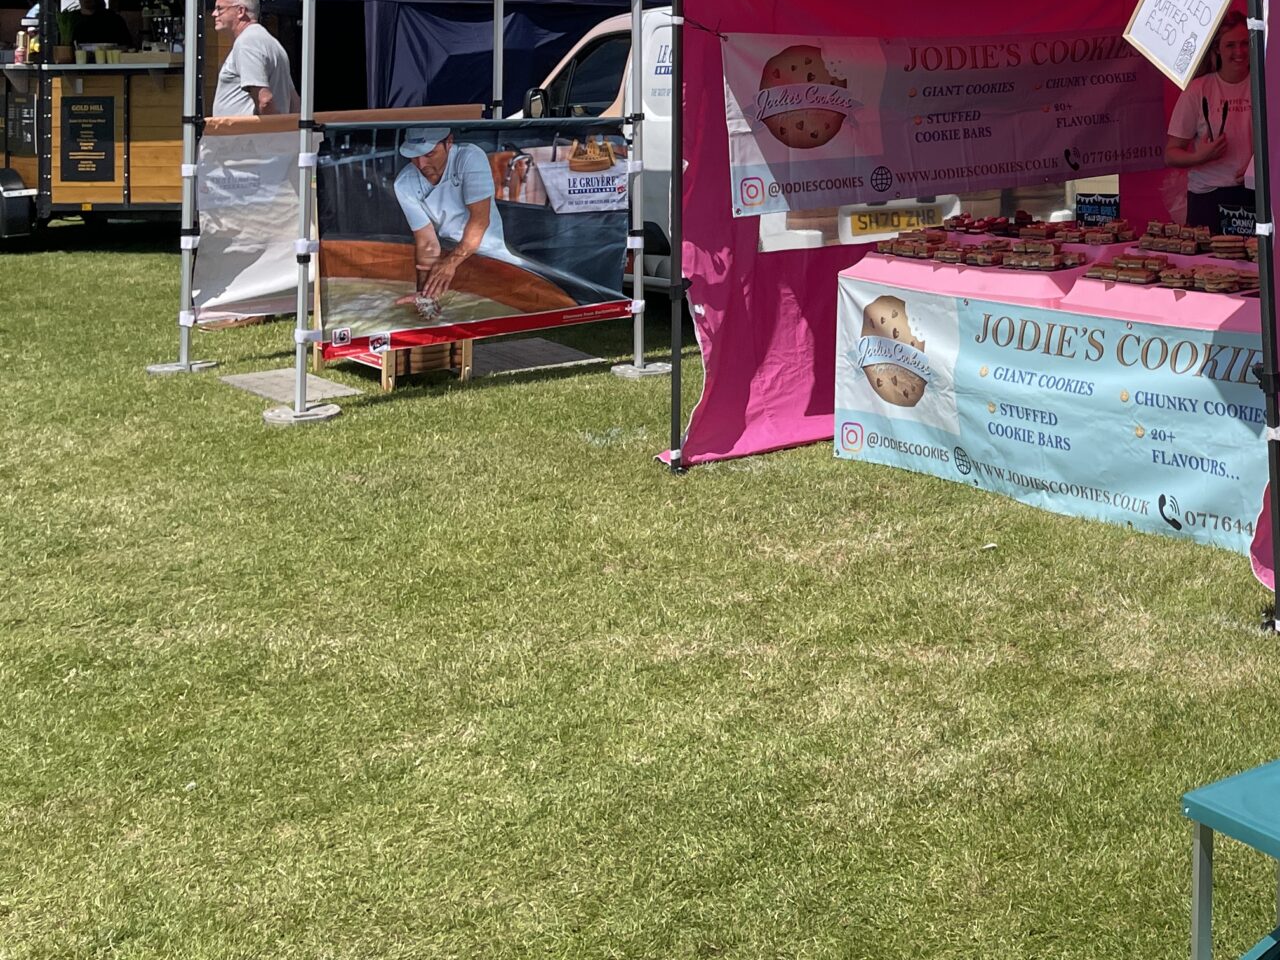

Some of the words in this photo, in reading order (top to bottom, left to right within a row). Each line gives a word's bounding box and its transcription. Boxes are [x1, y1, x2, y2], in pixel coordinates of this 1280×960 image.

[904, 43, 1021, 72] JODIE'S
[922, 84, 963, 98] GIANT
[966, 81, 1015, 96] COOKIES
[1046, 77, 1087, 90] CHUNKY
[1090, 72, 1137, 86] COOKIES
[805, 86, 852, 108] Cookies
[1054, 103, 1072, 112] 20+
[927, 110, 981, 124] STUFFED
[915, 129, 960, 143] COOKIE
[963, 126, 992, 139] BARS
[895, 157, 1059, 185] WWW.JODIESCOOKIES.CO.UK
[568, 178, 577, 188] LE
[768, 176, 864, 198] @JODIESCOOKIES
[975, 313, 1105, 362] JODIE'S
[993, 366, 1036, 388] GIANT
[1038, 374, 1095, 397] COOKIES
[1135, 390, 1198, 413] CHUNKY
[1000, 403, 1058, 426] STUFFED
[867, 432, 950, 462] @JODIESCOOKIES
[988, 421, 1035, 445] COOKIE
[1038, 432, 1071, 451] BARS
[1150, 428, 1176, 443] 20+
[1151, 449, 1240, 480] FLAVOURS...
[971, 459, 1151, 516] WWW.JODIESCOOKIES.CO.UK
[1185, 510, 1255, 537] 077644
